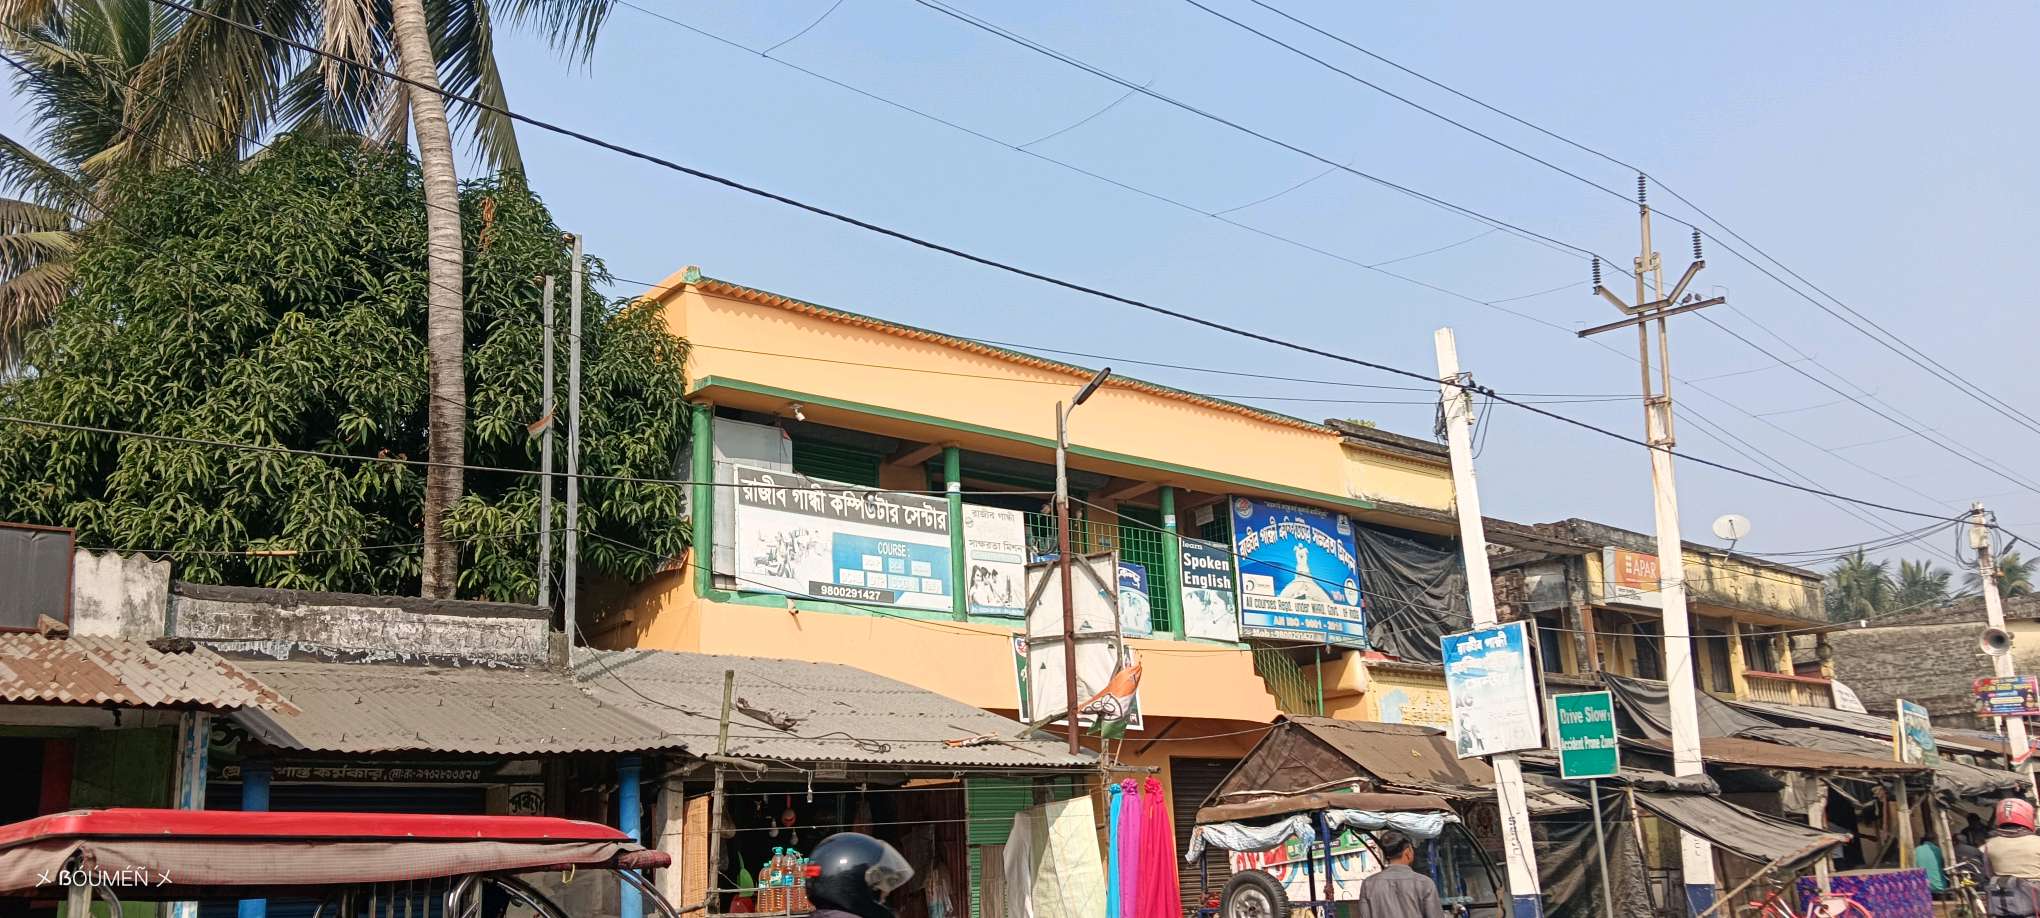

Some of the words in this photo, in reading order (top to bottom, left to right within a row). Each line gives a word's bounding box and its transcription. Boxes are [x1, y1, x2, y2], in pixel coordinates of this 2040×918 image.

[741, 475, 788, 507] রাজীব
[792, 483, 826, 513] গান্ধী
[902, 501, 948, 531] সেন্টার
[1182, 541, 1203, 550] learn
[1183, 553, 1230, 571] Spoken
[1633, 559, 1657, 578] APAR
[1184, 571, 1231, 589] English
[820, 586, 881, 600] 9800291427
[1560, 708, 1583, 724] Drive
